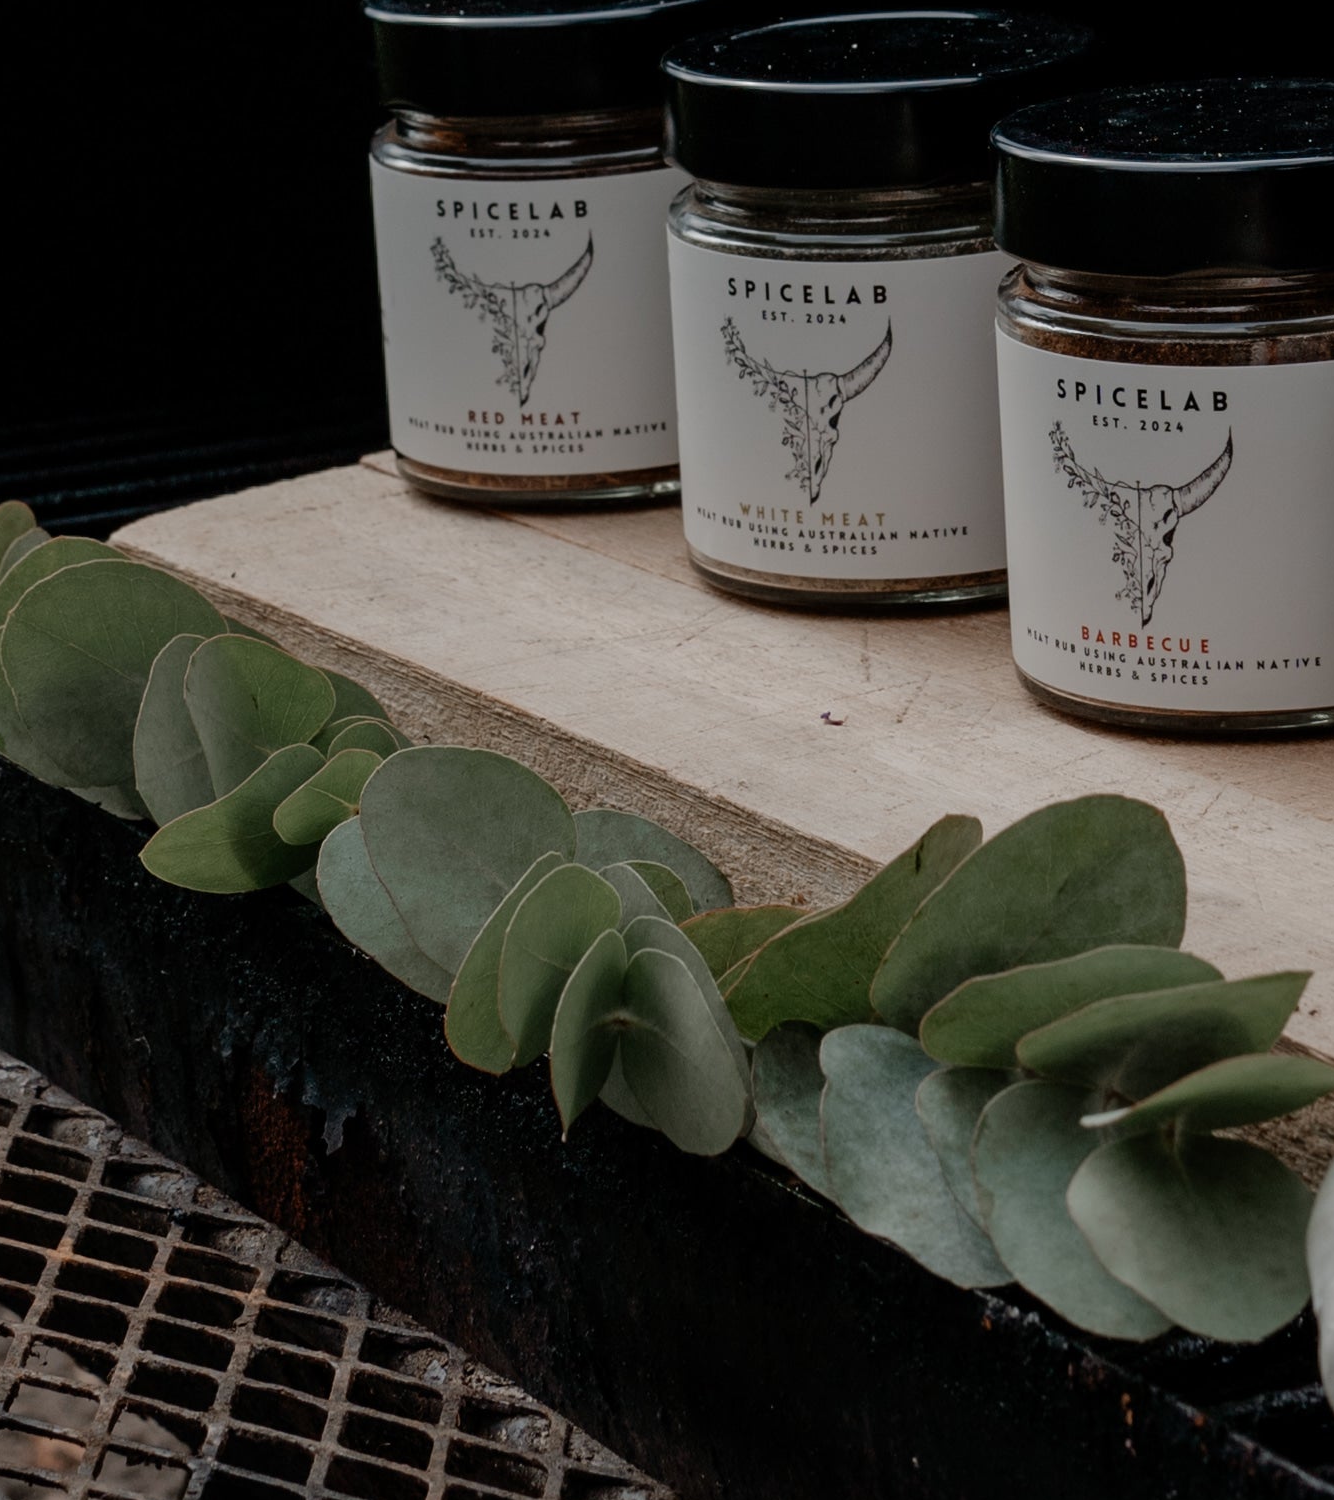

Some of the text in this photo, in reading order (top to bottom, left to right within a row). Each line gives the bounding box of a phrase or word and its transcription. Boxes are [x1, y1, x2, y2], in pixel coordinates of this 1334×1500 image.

[436, 199, 588, 221] SPICELAB
[470, 228, 551, 239] EST. 2024
[728, 277, 888, 305] SPICELAB
[761, 309, 847, 324] EST. 2024
[1057, 378, 1228, 412] SPICELAB
[468, 410, 581, 426] RED MEAT
[1092, 414, 1184, 433] EST. 2024
[461, 428, 500, 440] USING
[509, 429, 604, 441] AUSTRALIAN
[612, 421, 667, 436] NATIVE
[466, 442, 506, 453] HERBS
[532, 443, 585, 454] SPICES
[739, 502, 886, 527] WHITE MEAT
[722, 515, 742, 529] RUB
[748, 522, 788, 537] USING
[798, 529, 898, 541] AUSTRALIAN
[909, 525, 969, 540] NATIVE
[753, 537, 795, 552] HERBS
[822, 544, 878, 556] SPICES
[1081, 626, 1210, 654] BARBECUE
[1055, 638, 1077, 654] RUB
[1084, 646, 1127, 663] USING
[1137, 655, 1245, 671] AUSTRALIAN
[1257, 656, 1323, 671] NATIVE
[1079, 660, 1122, 678] HERBS
[1151, 673, 1210, 686] SPICES
